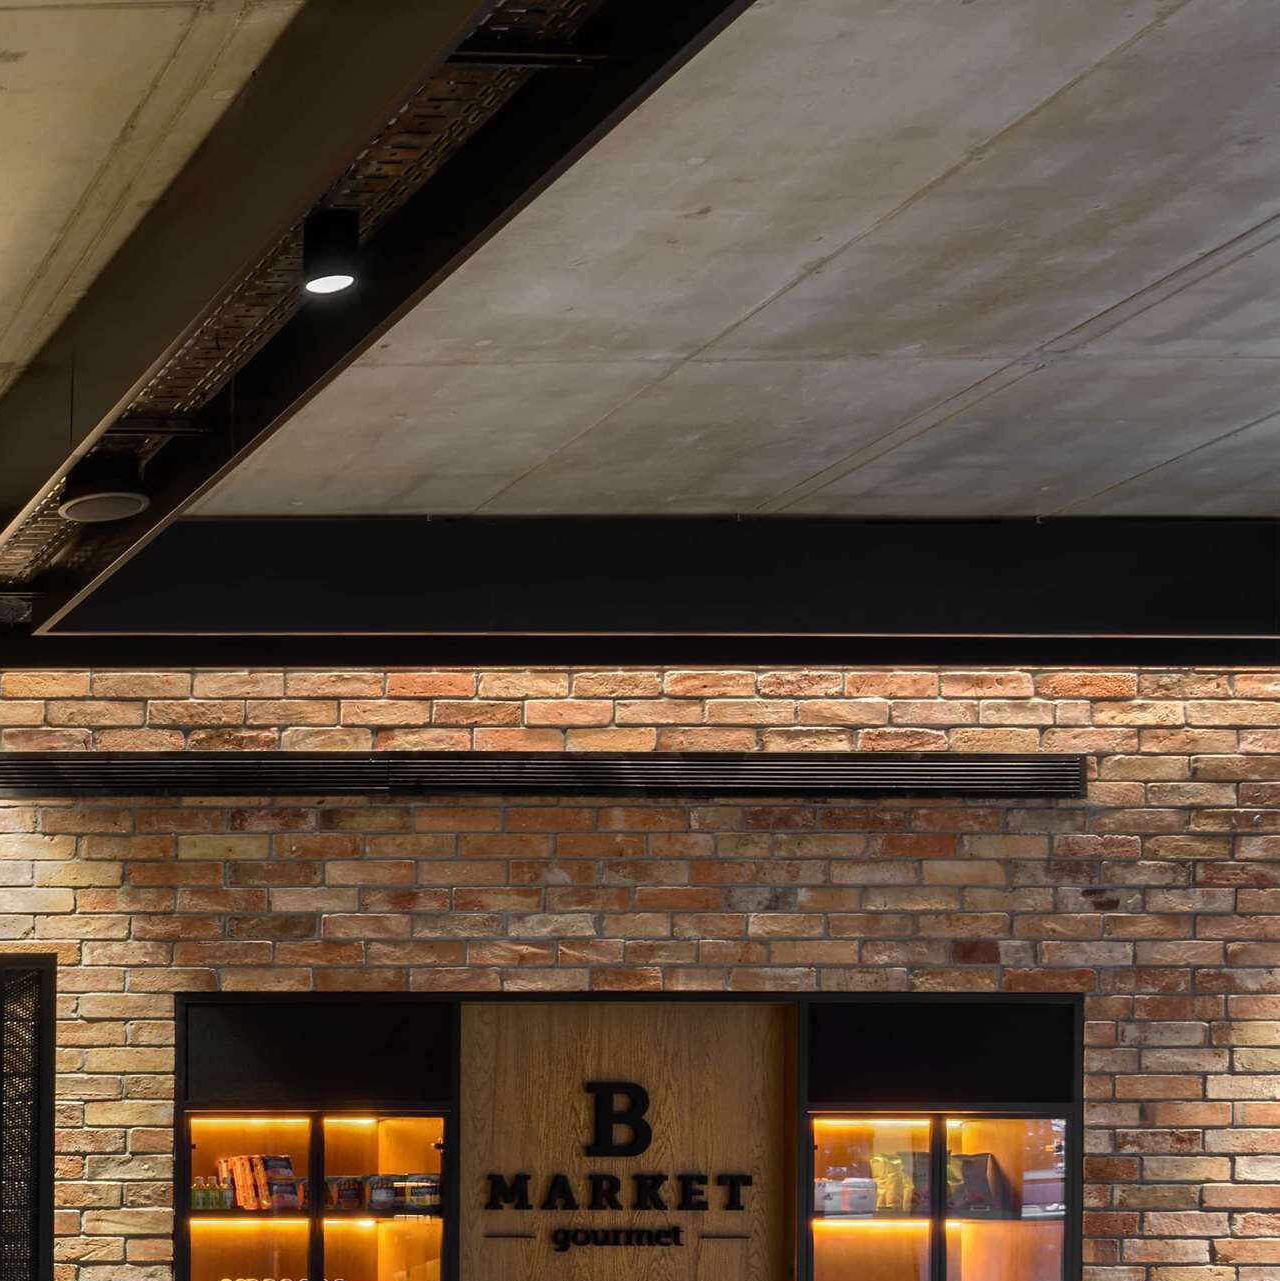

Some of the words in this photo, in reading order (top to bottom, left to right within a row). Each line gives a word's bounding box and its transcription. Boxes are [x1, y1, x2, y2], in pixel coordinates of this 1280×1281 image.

[585, 1081, 652, 1157] B
[485, 1173, 752, 1211] MARKET
[552, 1226, 684, 1252] gourmet
